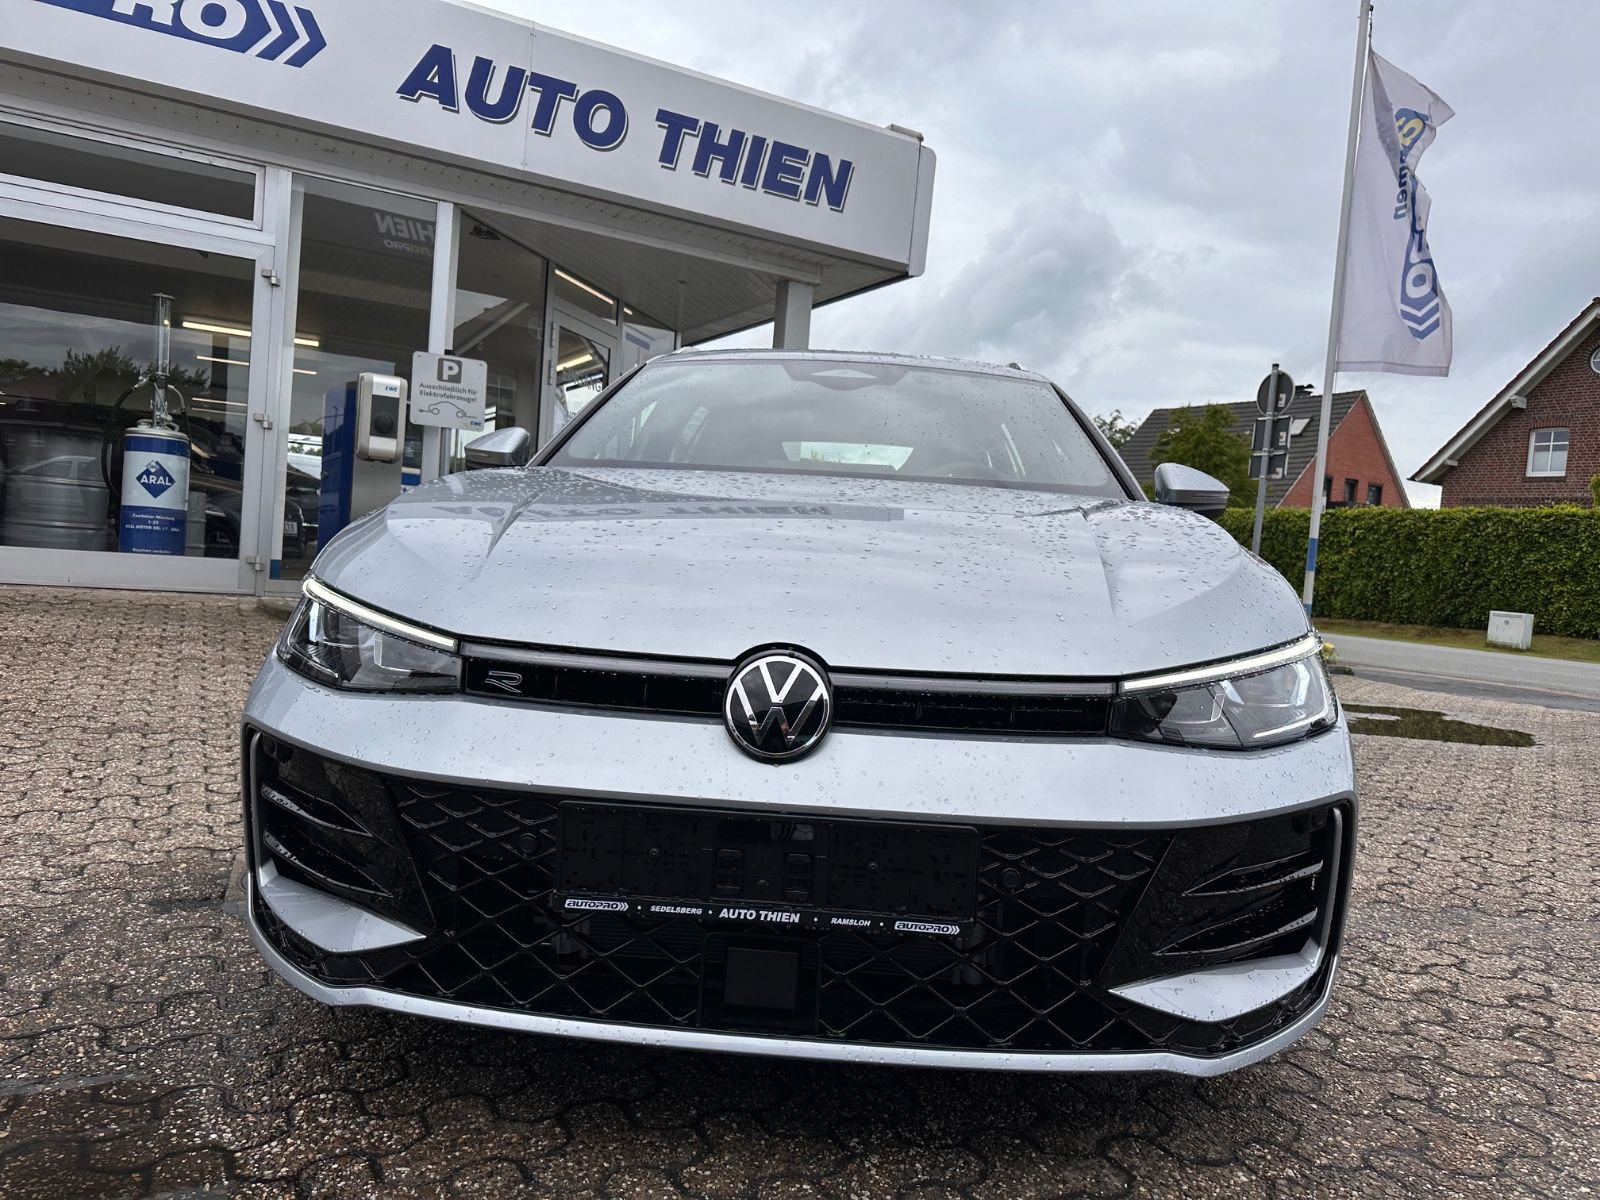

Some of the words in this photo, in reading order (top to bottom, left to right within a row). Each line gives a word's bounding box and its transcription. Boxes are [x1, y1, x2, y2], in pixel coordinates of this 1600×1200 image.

[396, 43, 628, 151] AUTO
[655, 108, 854, 212] THIEN
[442, 359, 460, 381] P
[420, 382, 467, 394] Ausschließlich
[468, 388, 478, 396] für
[140, 474, 172, 486] ARAL
[485, 669, 523, 694] R
[650, 904, 703, 915] SEDELSBERG
[719, 908, 756, 920] AUTO
[758, 910, 801, 923] THIEN
[831, 917, 871, 927] RAMSLOH
